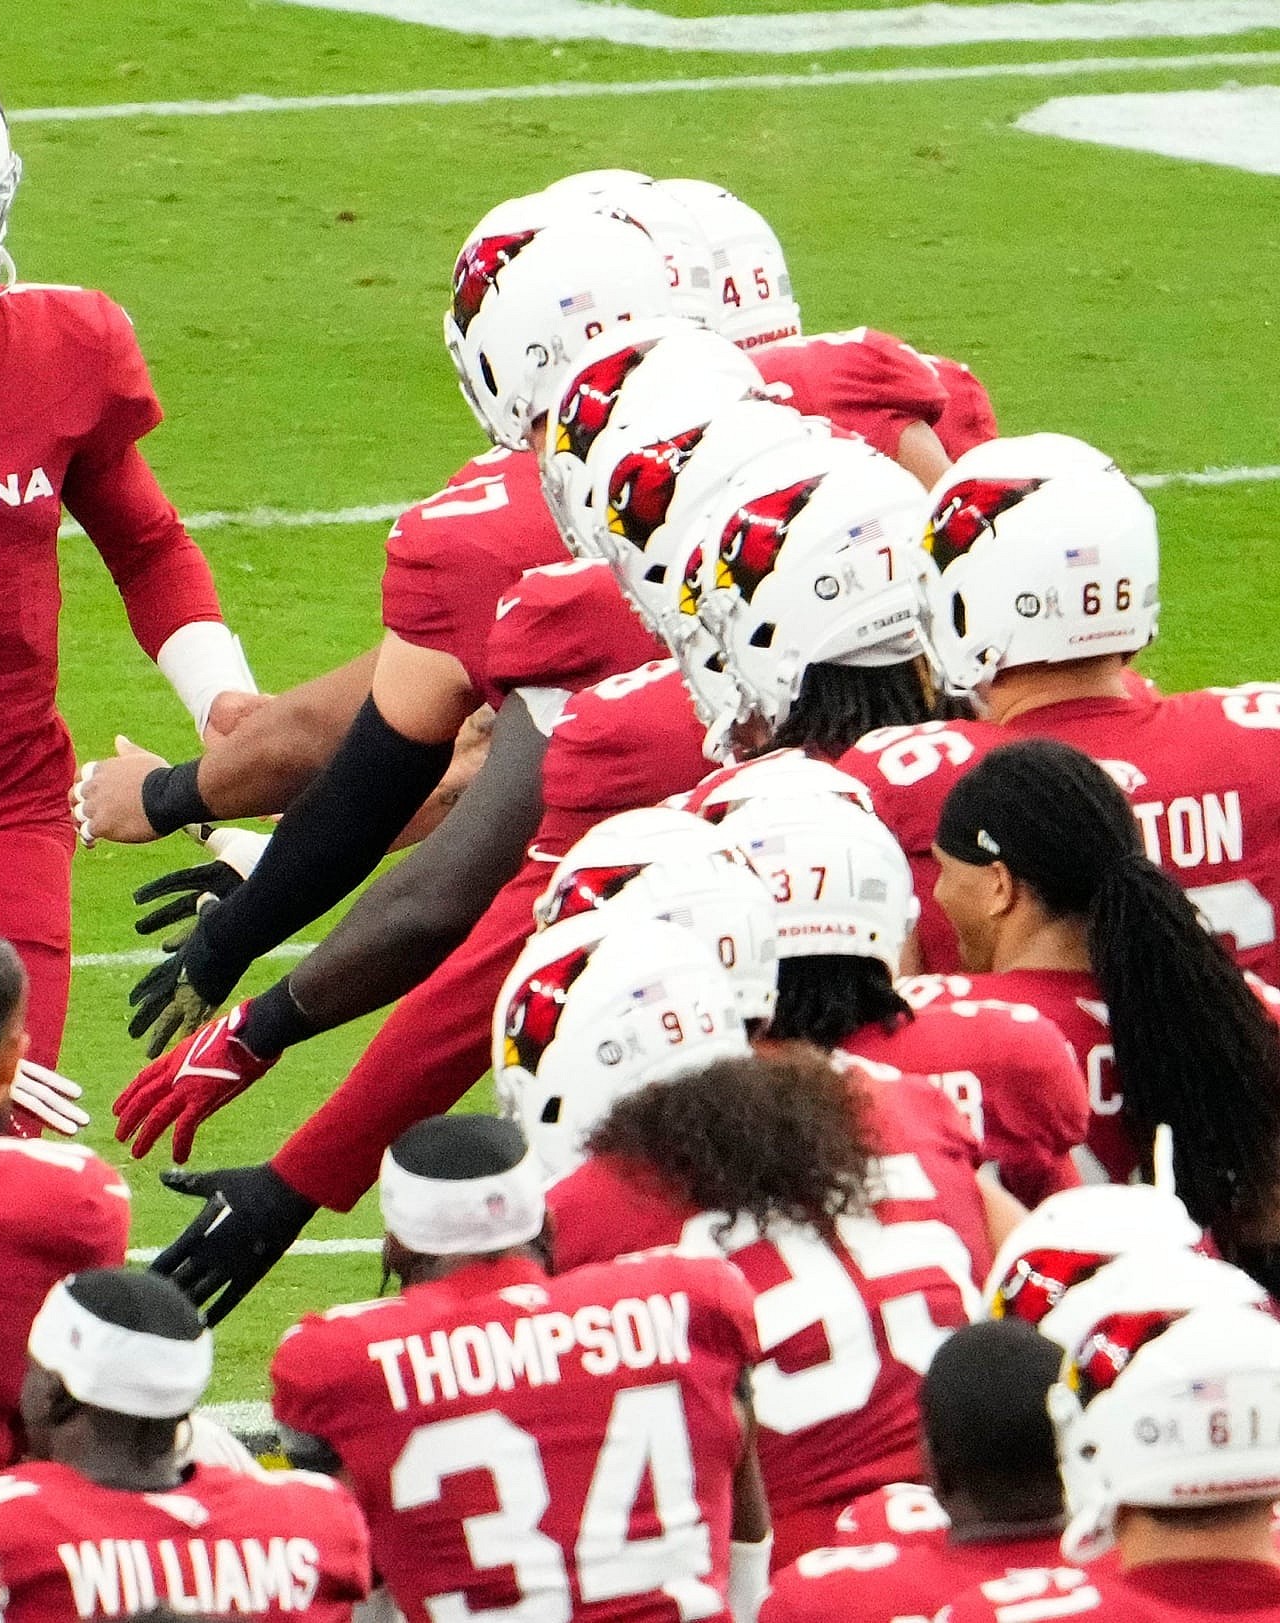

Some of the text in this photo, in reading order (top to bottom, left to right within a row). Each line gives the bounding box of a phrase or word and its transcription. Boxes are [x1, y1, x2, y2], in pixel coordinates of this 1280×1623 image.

[723, 267, 770, 308] 45
[1083, 577, 1131, 616] 66
[772, 866, 826, 903] 37
[368, 1291, 692, 1411] THOMPSON
[391, 1382, 712, 1623] 34
[58, 1537, 319, 1618] WILLIAMS
